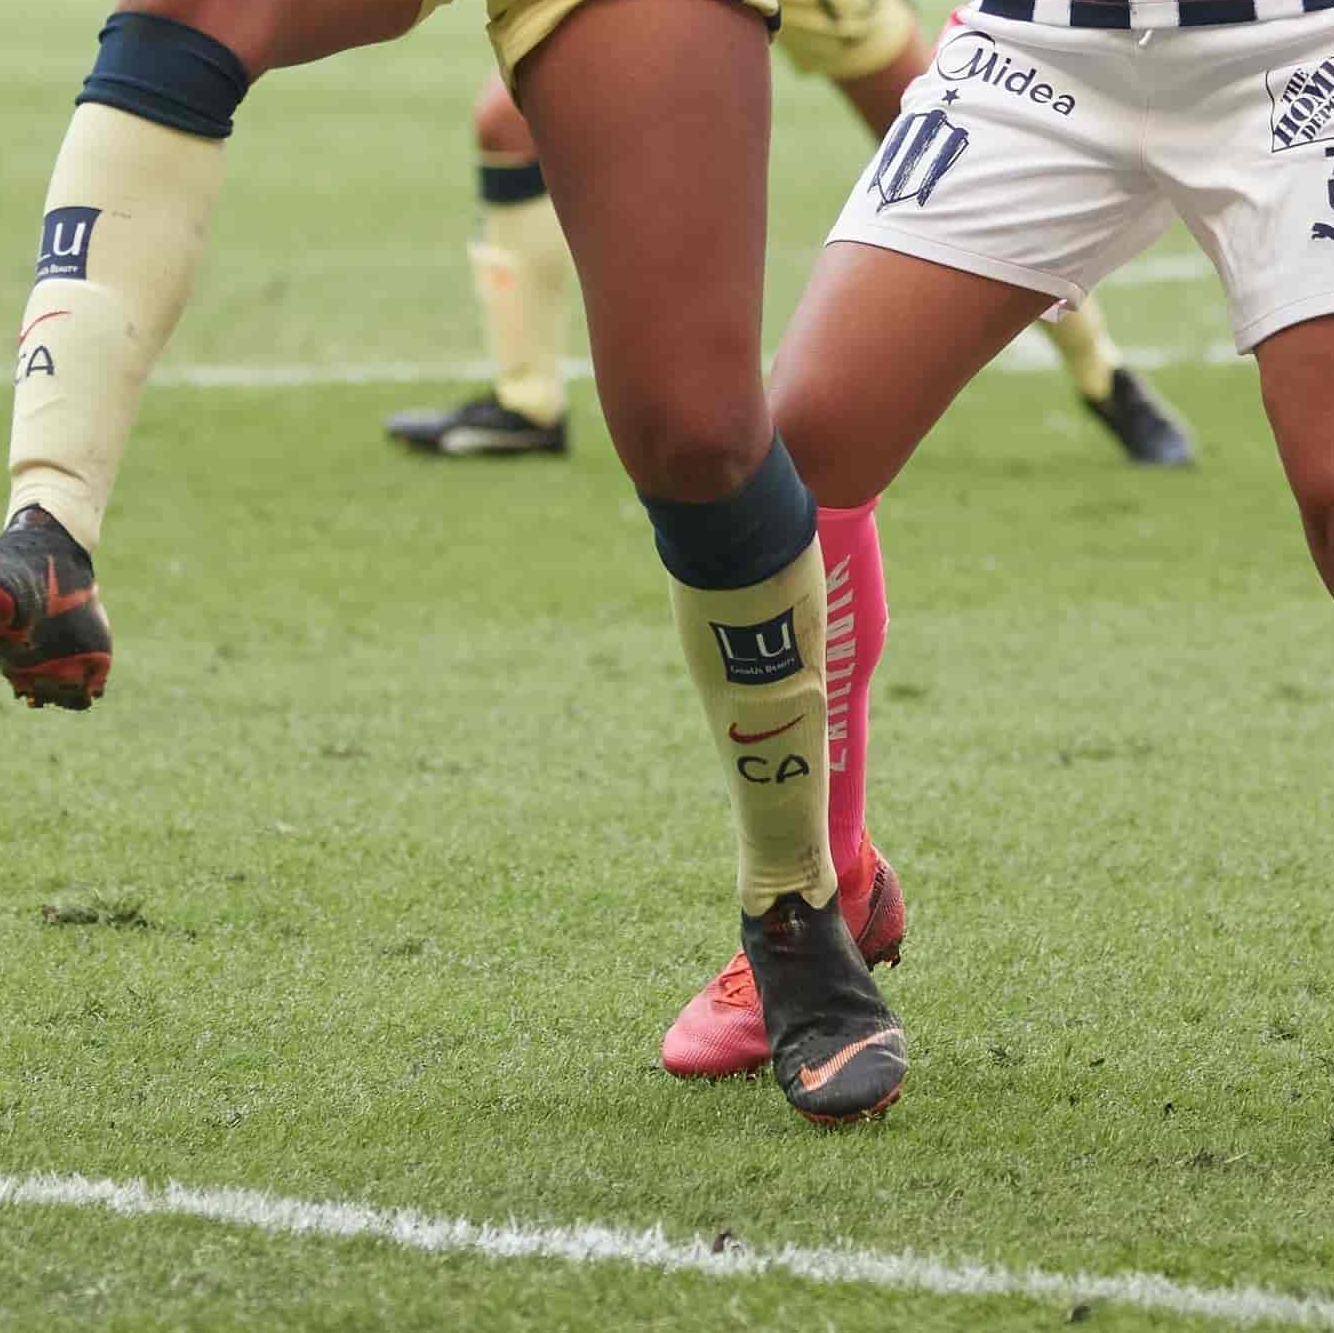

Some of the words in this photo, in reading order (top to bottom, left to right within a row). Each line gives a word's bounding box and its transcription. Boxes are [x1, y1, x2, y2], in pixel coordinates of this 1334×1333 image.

[937, 31, 1076, 116] Midea
[1280, 68, 1309, 103] THE
[736, 754, 810, 784] CA
